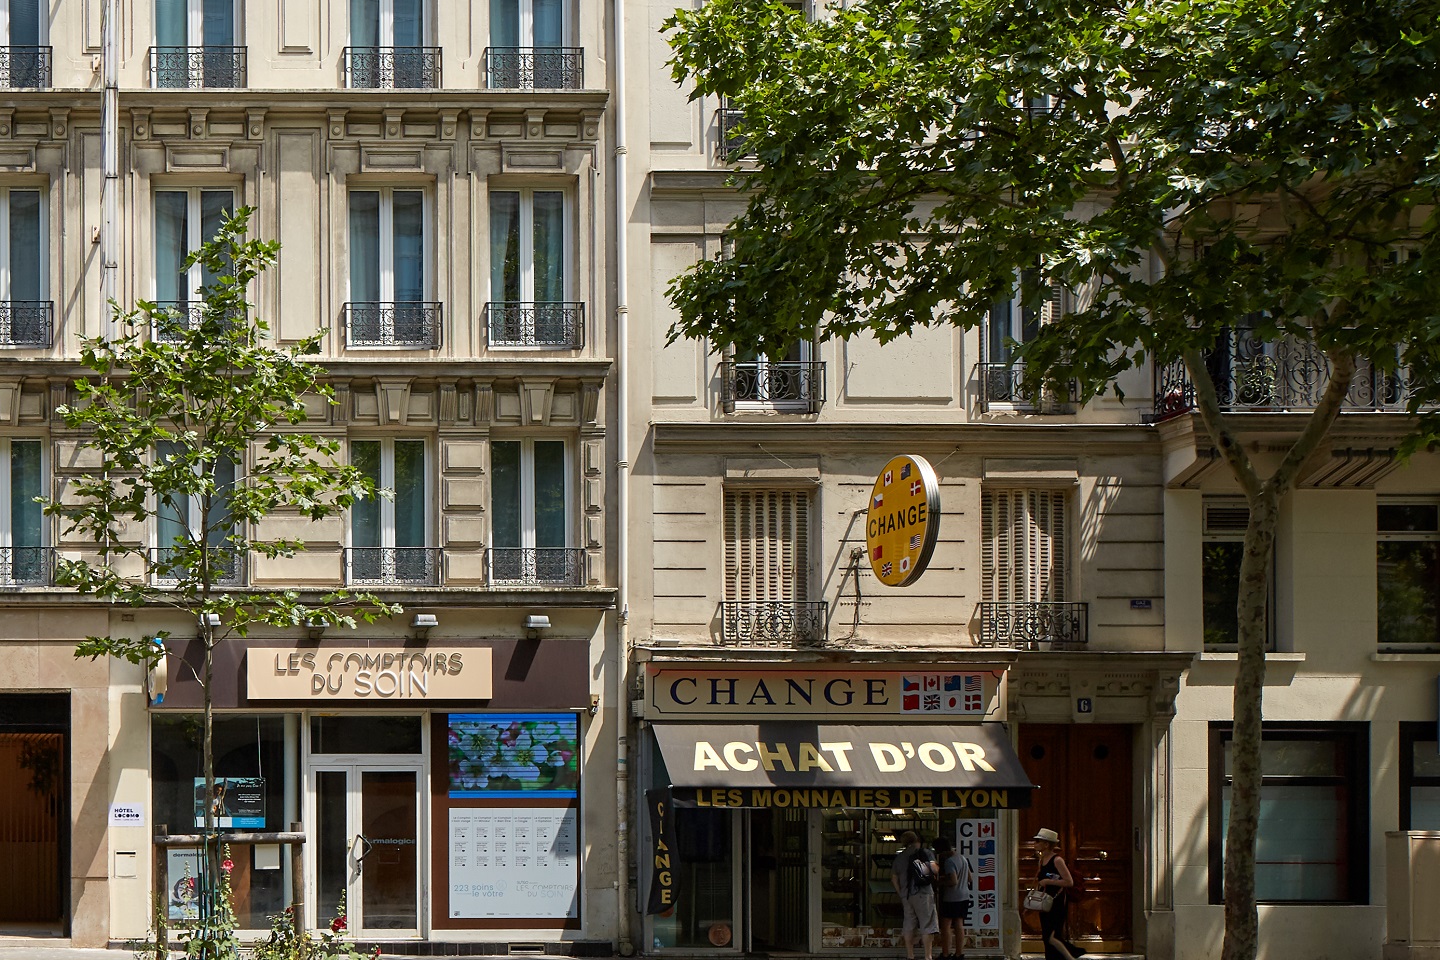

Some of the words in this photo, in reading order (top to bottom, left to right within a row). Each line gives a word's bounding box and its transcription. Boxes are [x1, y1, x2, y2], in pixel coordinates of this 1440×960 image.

[869, 502, 926, 538] CHANGE
[275, 652, 316, 673] LES
[327, 652, 464, 673] COMPTOIRS
[312, 673, 343, 692] DU
[354, 670, 428, 695] SOIN
[669, 677, 890, 707] CHANGE
[1080, 700, 1089, 711] 6
[693, 741, 854, 772] ACHAT
[868, 741, 997, 773] D'OR
[696, 789, 743, 807] LES
[752, 789, 891, 808] MONNAIES
[899, 789, 933, 808] DE
[945, 789, 1008, 808] LYON
[453, 884, 469, 892] 223
[471, 883, 494, 891] soins
